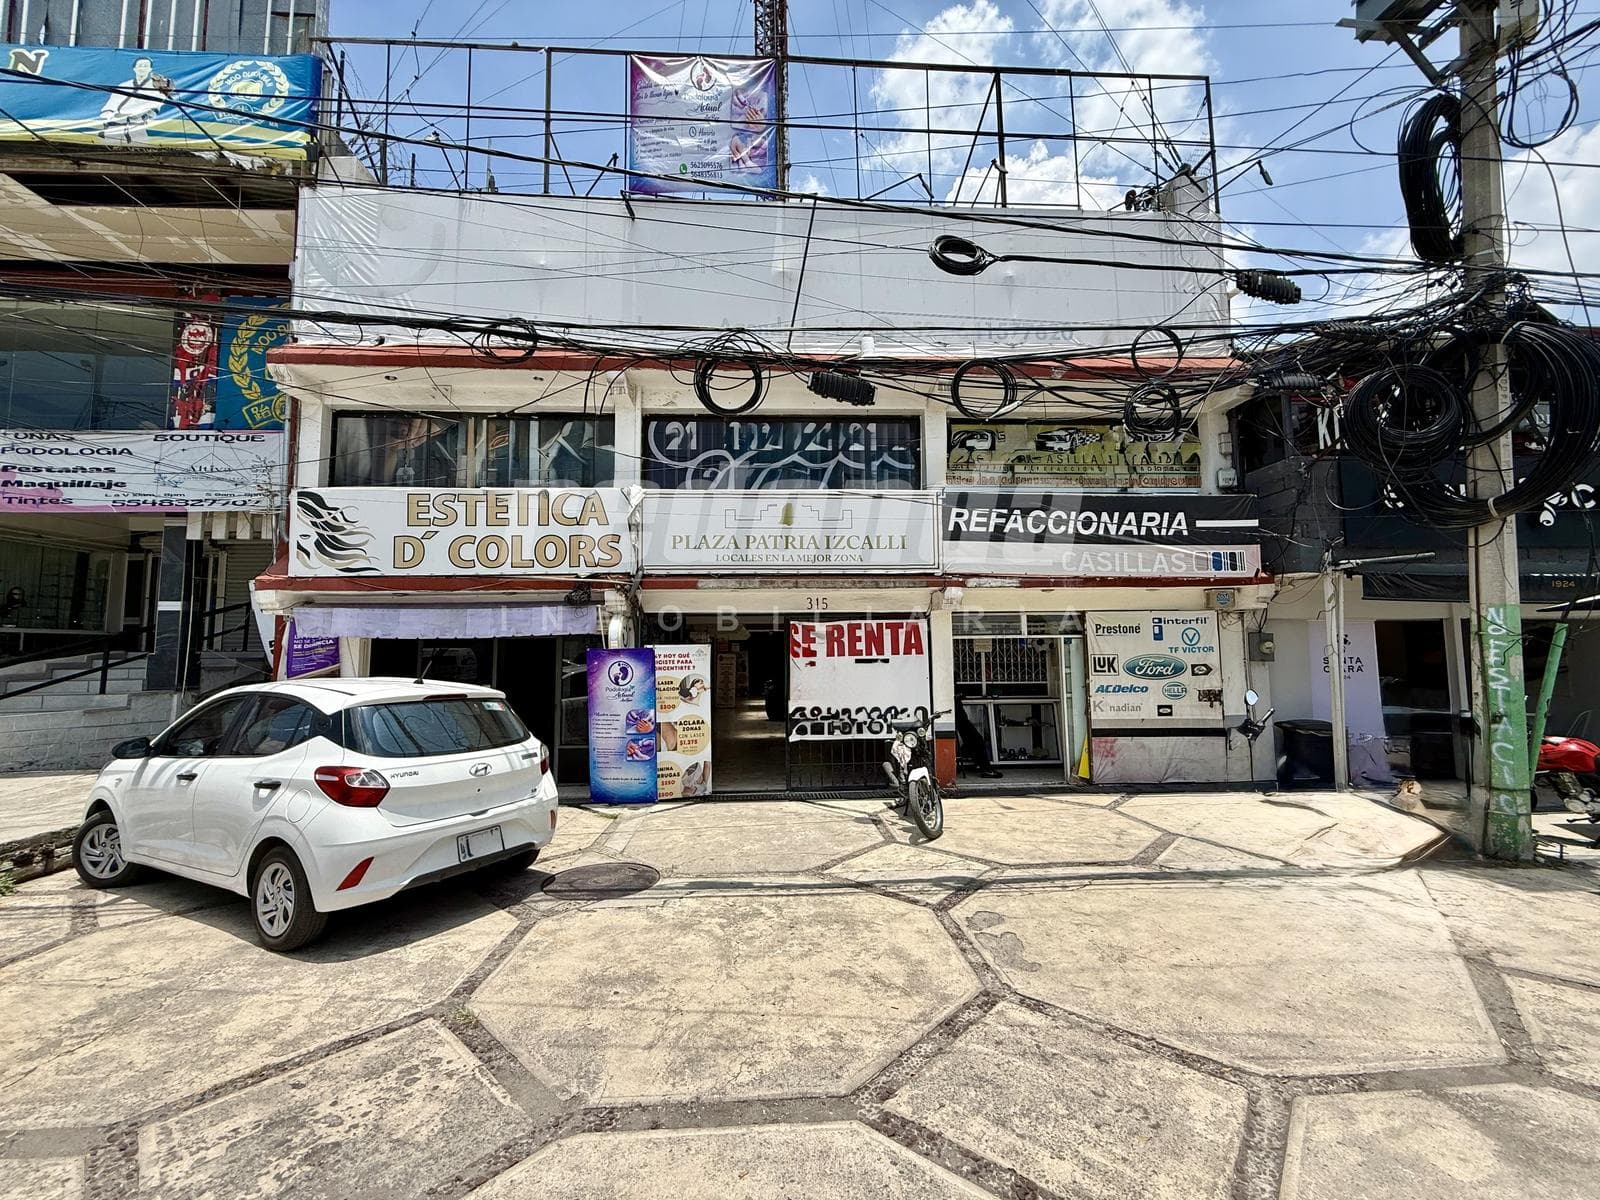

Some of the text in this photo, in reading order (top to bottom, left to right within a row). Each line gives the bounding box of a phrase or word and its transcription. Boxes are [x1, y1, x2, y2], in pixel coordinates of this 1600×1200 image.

[153, 434, 266, 444] BOUTIQUE
[0, 446, 134, 456] PODOLOGIA
[1, 464, 117, 474] Pestañas
[1, 479, 128, 490] Maquillaje
[2, 496, 74, 505] Tintes
[947, 507, 1189, 536] REFACCIONARIA
[671, 535, 908, 550] PLAZA PATRIA IZCALLI
[448, 534, 623, 570] COLORS
[715, 554, 864, 563] LOCALES EN LA MEJOR ZONA
[1061, 550, 1187, 573] CASILLAS
[1551, 580, 1576, 588] 1924
[806, 597, 829, 611] 315
[1095, 616, 1208, 636] Prestone interfil
[790, 622, 924, 658] SE RENTA
[1168, 645, 1215, 654] TF VICTOR
[1134, 658, 1175, 676] Ford
[1094, 684, 1149, 694] ACDelco
[390, 770, 420, 779] HYUNDAI
